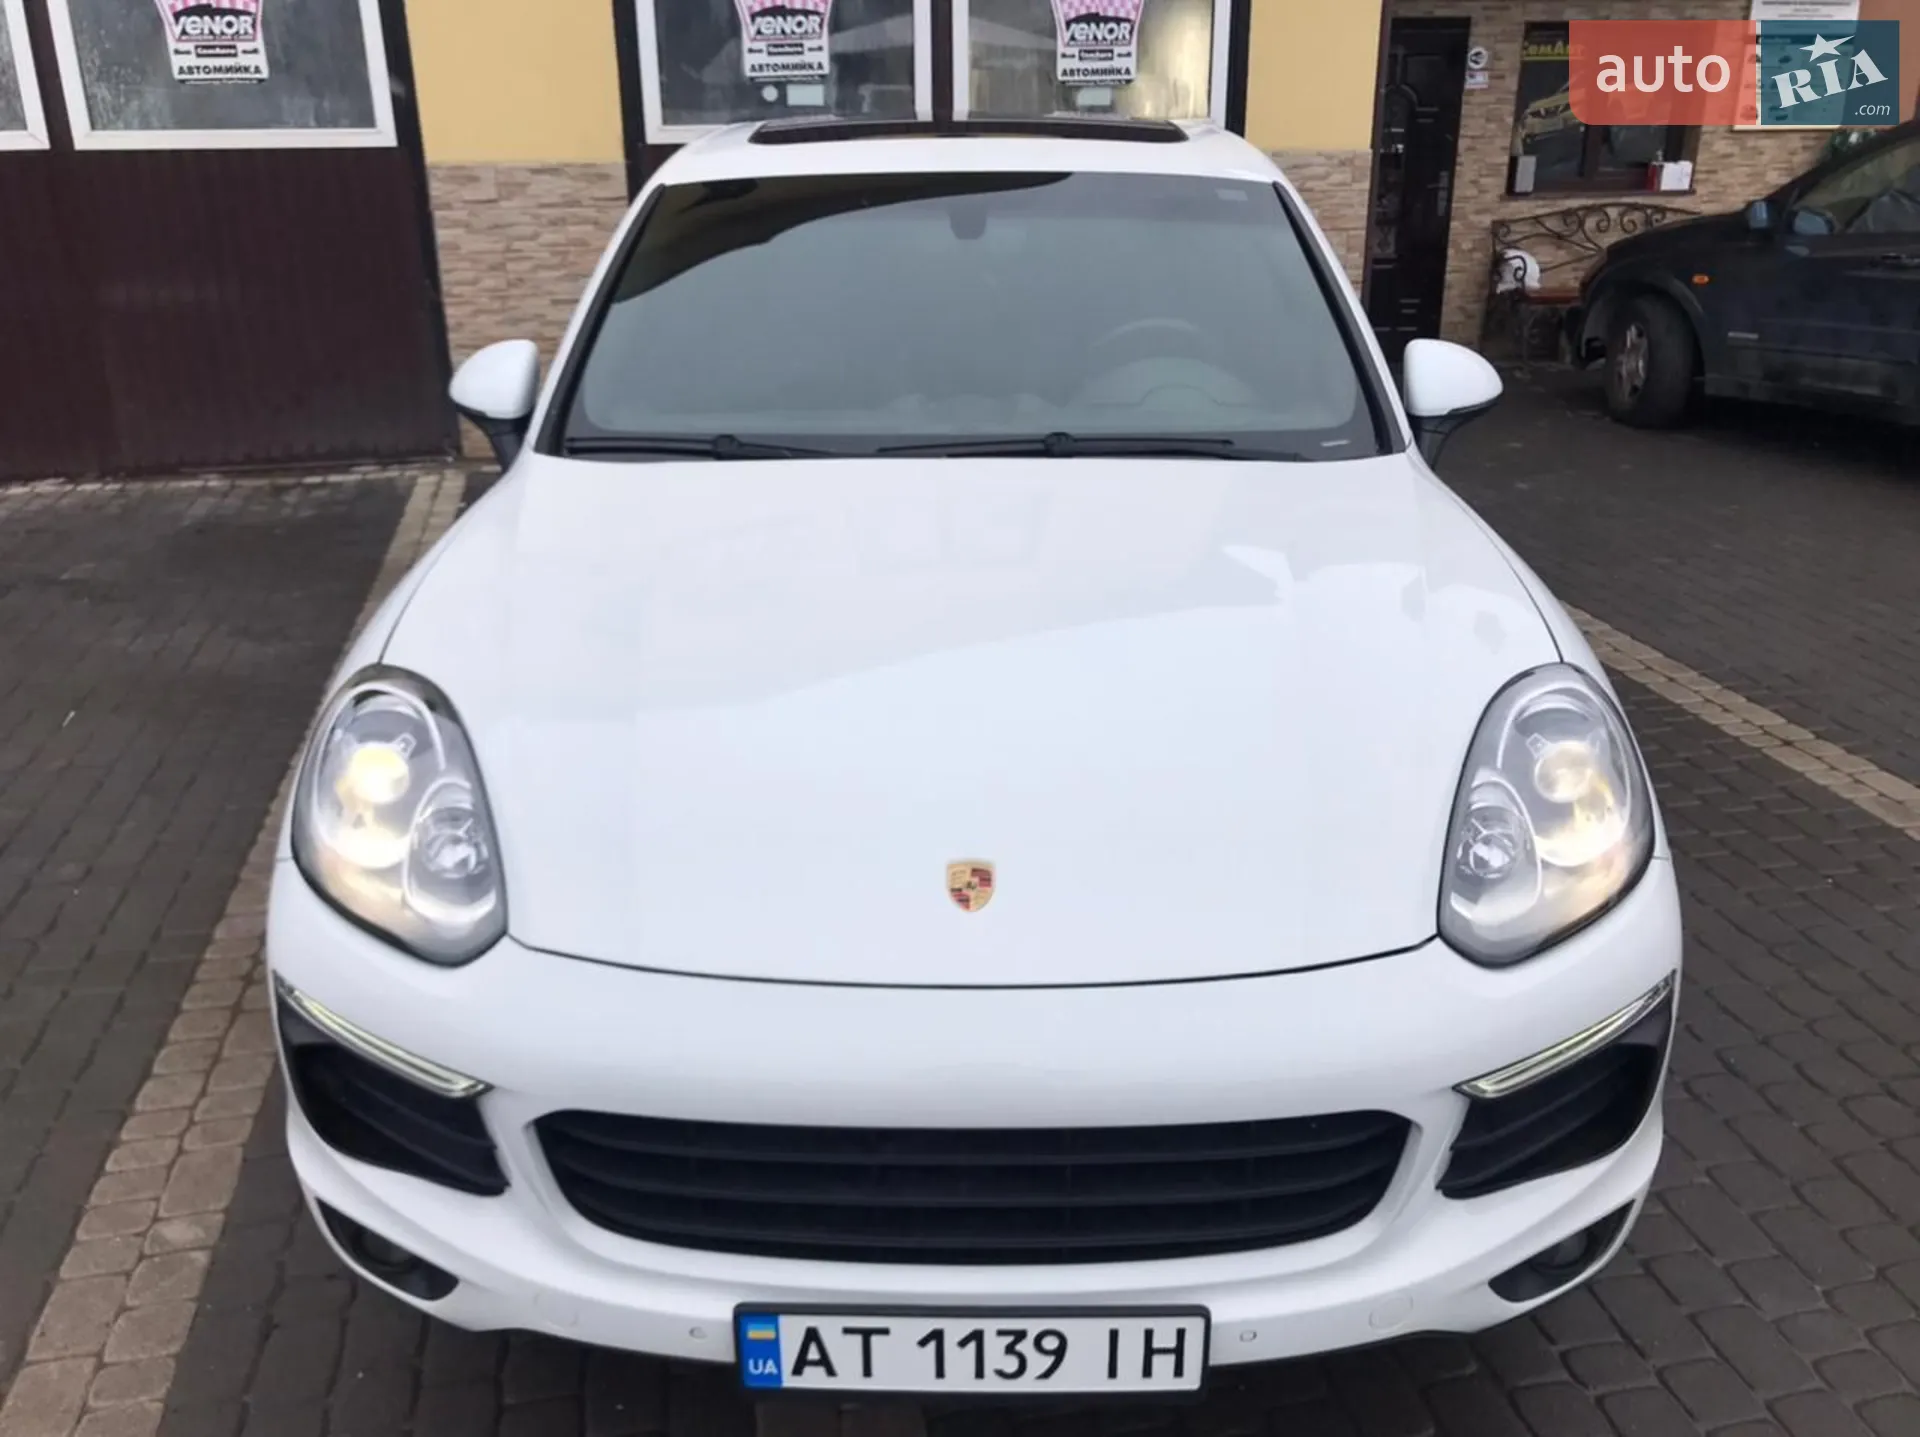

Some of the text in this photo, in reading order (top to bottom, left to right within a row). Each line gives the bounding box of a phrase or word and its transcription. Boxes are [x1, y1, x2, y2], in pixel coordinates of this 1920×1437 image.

[178, 62, 262, 76] АВТОМИЙКА
[750, 60, 824, 73] АВТОМИЙКА
[1061, 65, 1131, 77] АВТОМИЙКА
[791, 1326, 1187, 1380] AT 1139 IH
[748, 1358, 778, 1375] UA
